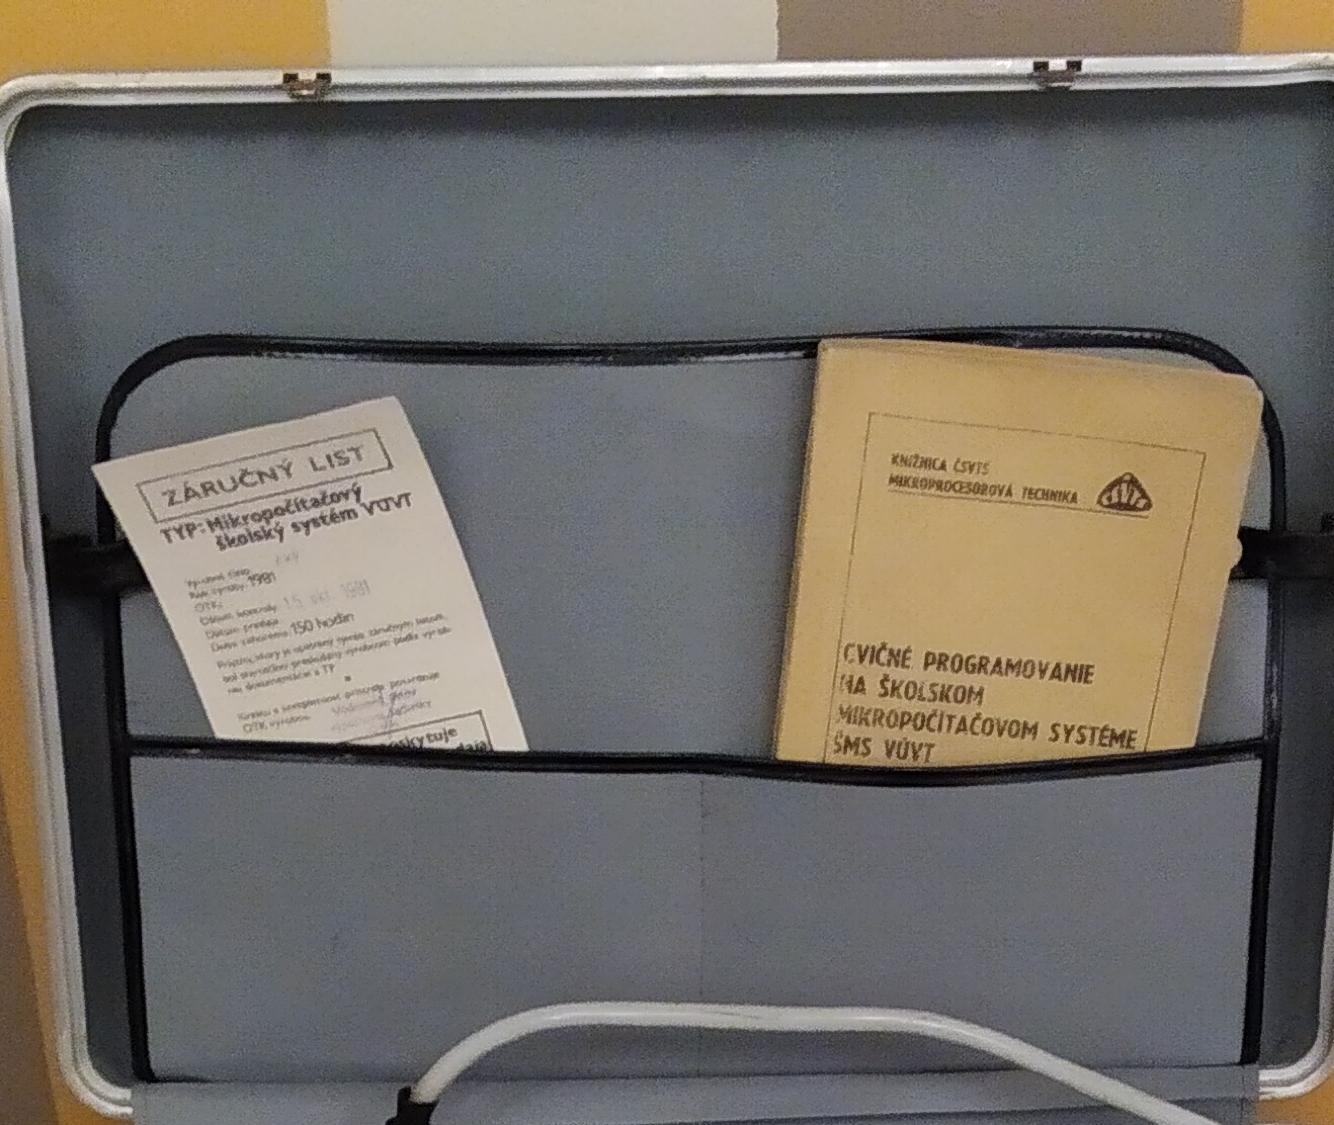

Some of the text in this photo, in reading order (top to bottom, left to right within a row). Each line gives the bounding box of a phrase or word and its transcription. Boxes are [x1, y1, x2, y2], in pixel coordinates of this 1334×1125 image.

[161, 445, 365, 507] ZÁRUČNÝ LIST
[891, 453, 948, 473] KNIŽNICA
[888, 474, 1079, 504] MIKROPROCESOROVÁ TECHNIKA
[160, 522, 206, 544] TYP:
[291, 506, 359, 537] systém
[843, 641, 1096, 685] CVIČNÉ PROGRAMOVANIE
[840, 674, 985, 707] NA ŠKOLSKOM
[838, 704, 1139, 750] MIKROPOČÍTAČOVOM SYSTÉME
[833, 731, 936, 764] ŠMS VÚVT
